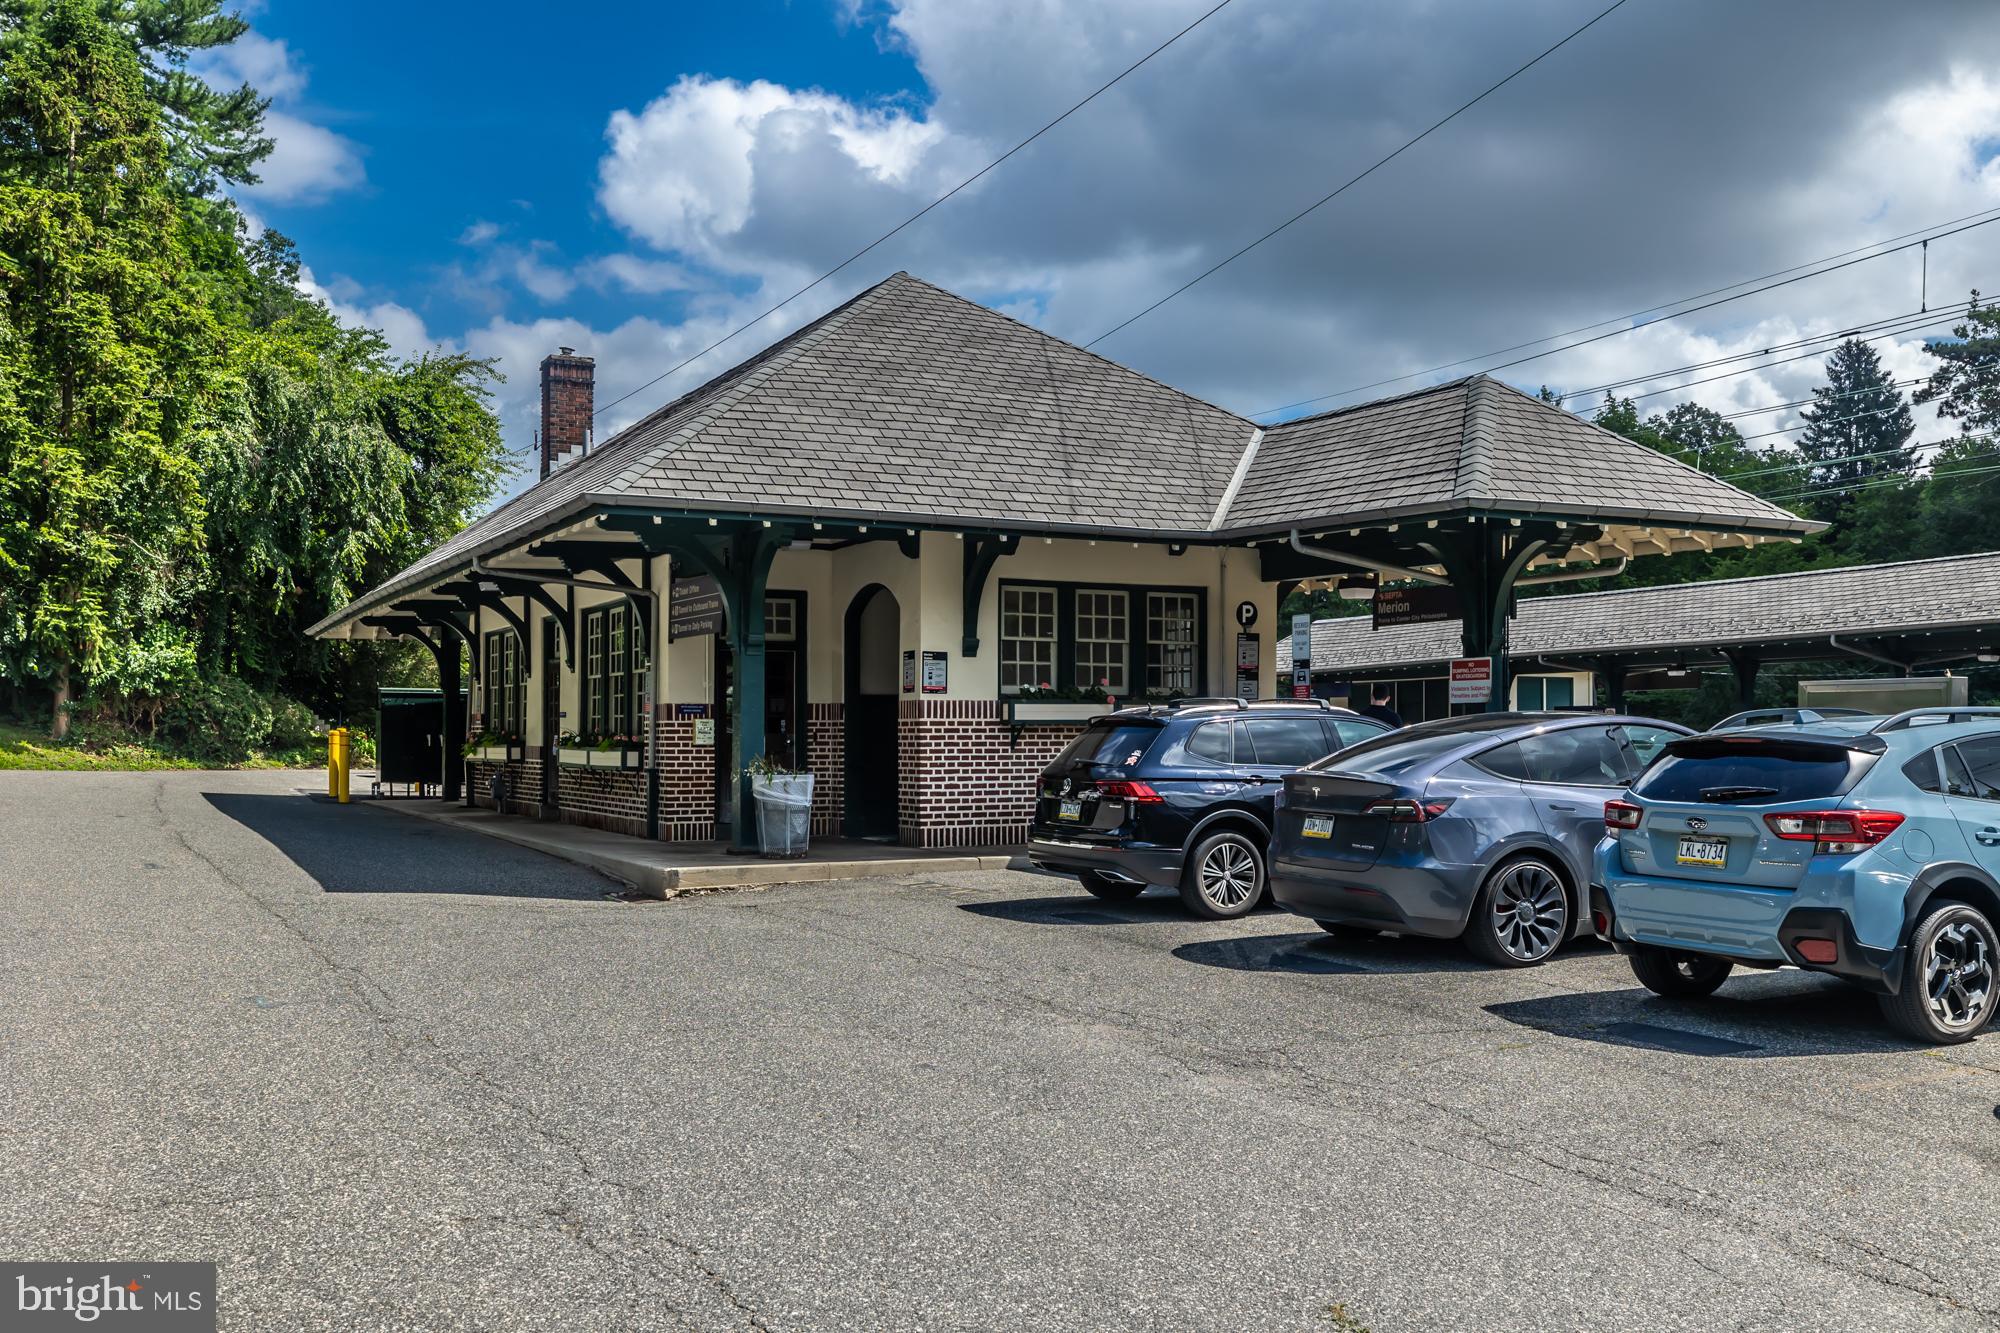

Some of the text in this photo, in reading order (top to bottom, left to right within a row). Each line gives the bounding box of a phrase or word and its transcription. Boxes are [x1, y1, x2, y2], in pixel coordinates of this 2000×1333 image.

[1384, 591, 1403, 600] SEPTA
[1242, 605, 1254, 623] P
[1378, 601, 1410, 614] Merion
